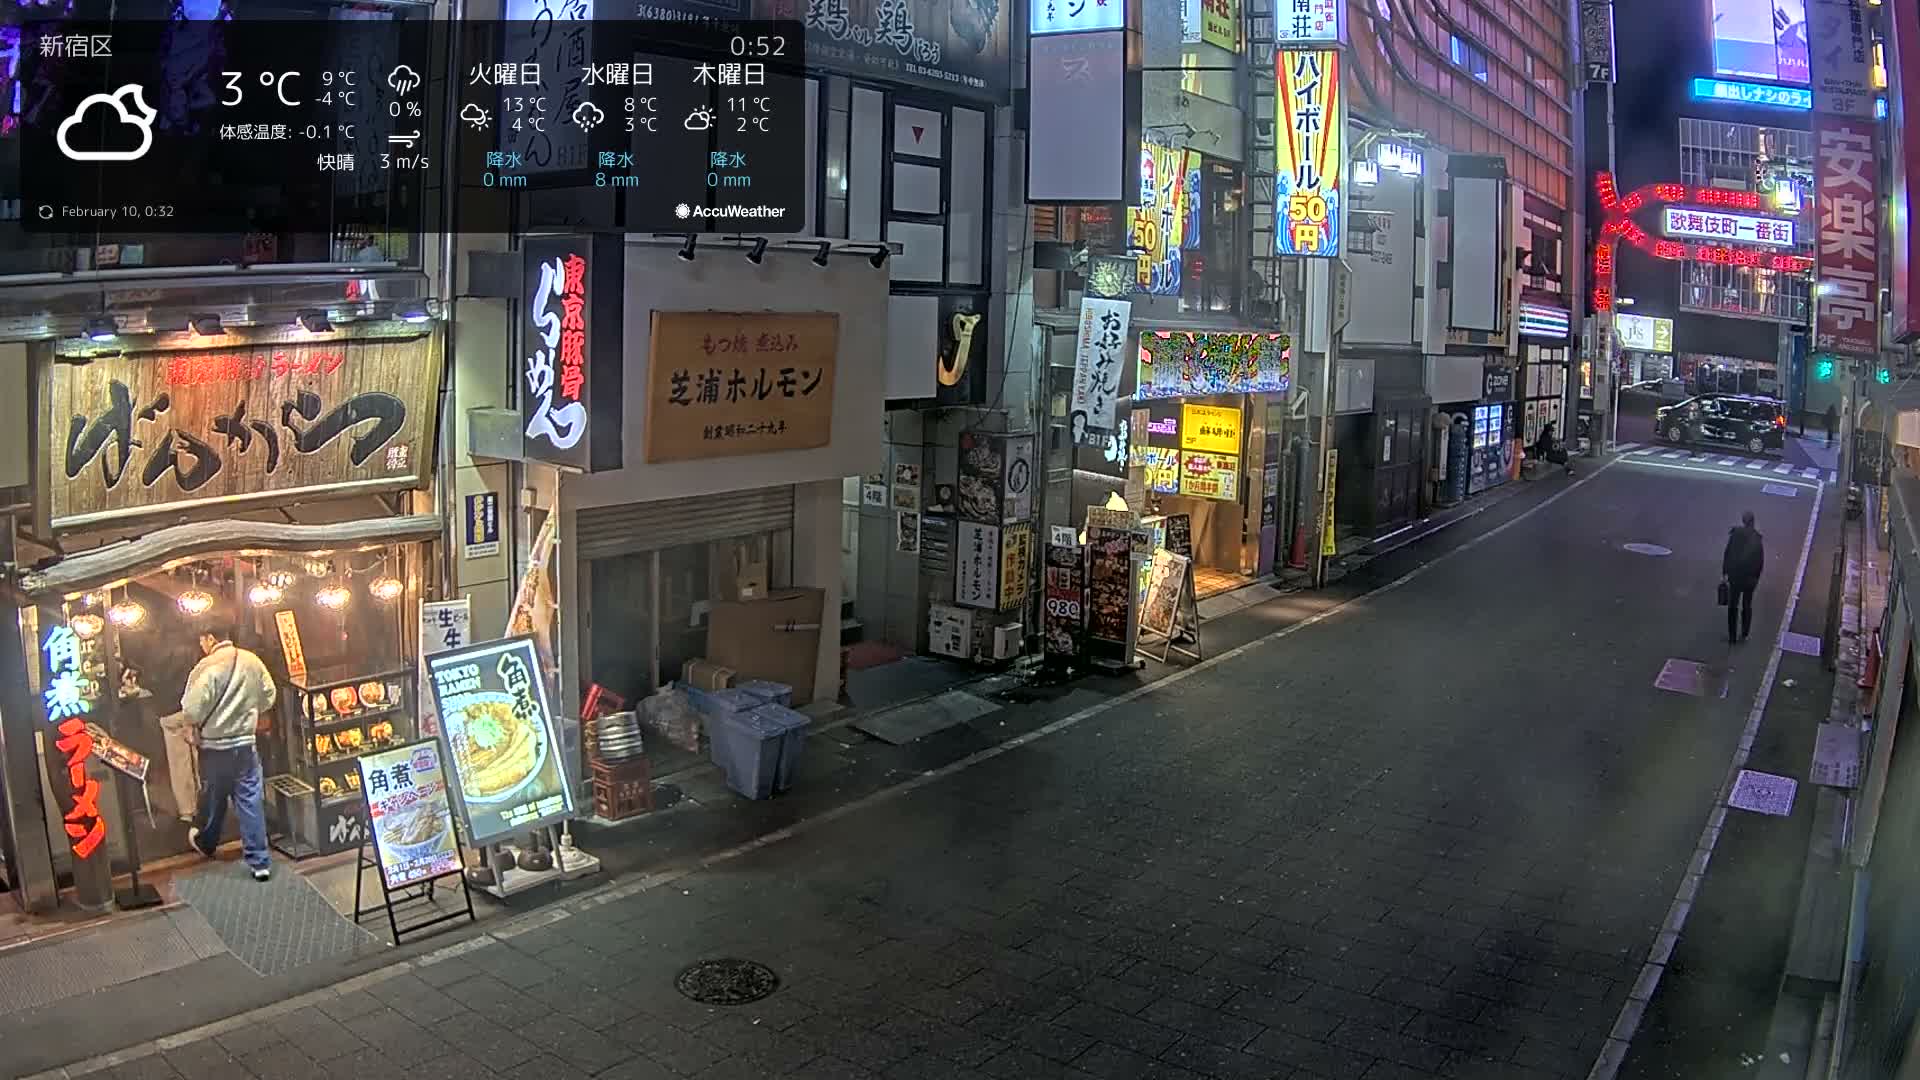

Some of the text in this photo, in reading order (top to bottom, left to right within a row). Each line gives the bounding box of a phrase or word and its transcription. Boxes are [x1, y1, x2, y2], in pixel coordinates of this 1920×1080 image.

[1589, 64, 1610, 80] 7F
[1294, 54, 1321, 190] ハイボール
[1289, 196, 1327, 222] 50
[1133, 217, 1157, 251] 50
[1295, 224, 1319, 252] 円
[1669, 211, 1790, 243] 歌舞伎町一番街
[1819, 128, 1876, 331] 安楽亭
[561, 252, 586, 401] 東京豚骨
[668, 367, 823, 407] 芝浦ホルモン
[1047, 600, 1080, 617] 980
[434, 664, 481, 684] TOKYO
[498, 654, 538, 720] 角煮
[368, 763, 413, 795] 角煮
